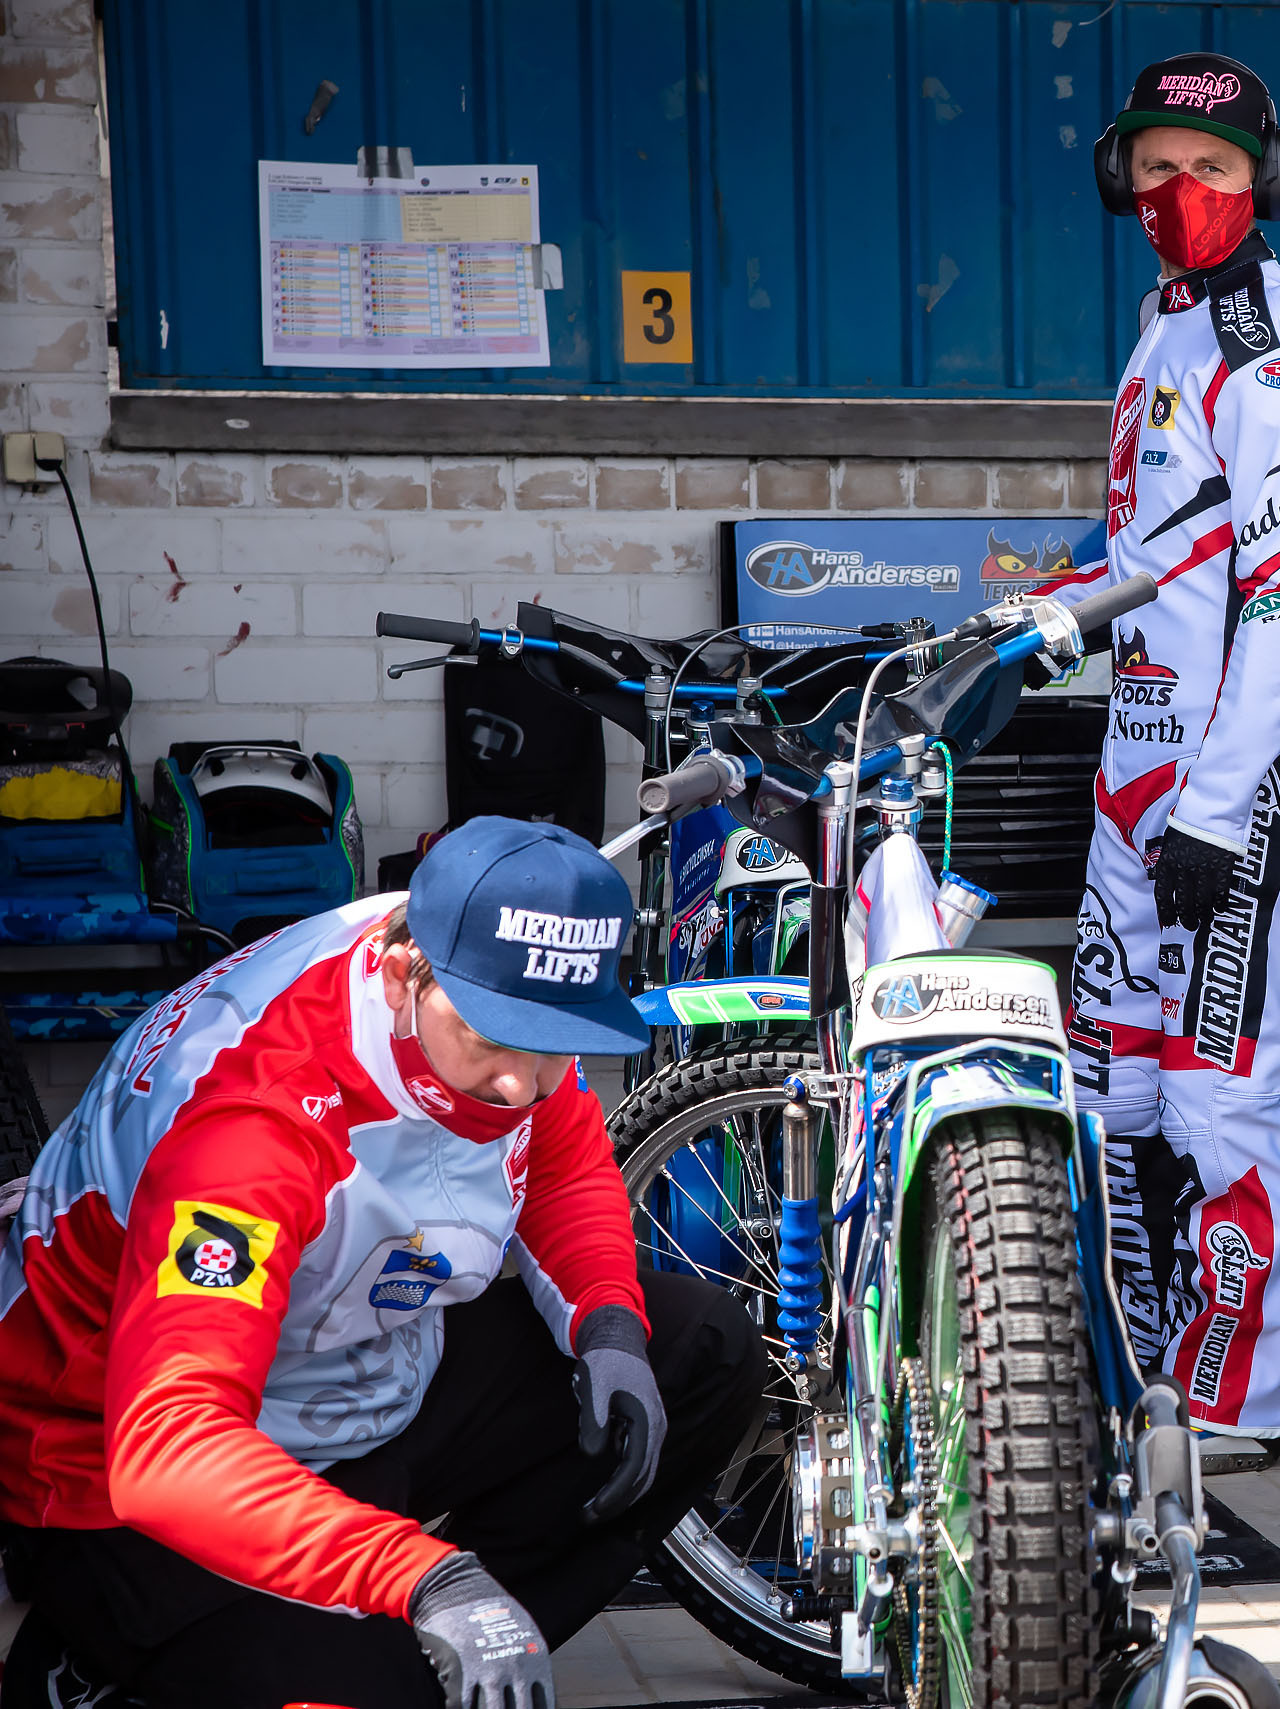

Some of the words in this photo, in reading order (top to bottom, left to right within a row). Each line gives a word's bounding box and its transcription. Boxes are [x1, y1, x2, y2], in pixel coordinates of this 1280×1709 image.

[1157, 75, 1225, 97] MERIDIAN
[1165, 90, 1206, 107] LIFTS
[642, 287, 675, 345] 3
[812, 551, 861, 566] Hans
[830, 564, 959, 585] Andersen
[1110, 709, 1185, 744] North
[496, 906, 623, 951] MERIDIAN
[523, 947, 600, 985] LIFTS
[920, 973, 969, 991] Hans
[1195, 891, 1256, 1068] MERIDIAN
[936, 987, 1050, 1012] Andersen
[1069, 942, 1115, 1097] LIFTS
[1219, 1245, 1246, 1307] LIFTS
[1192, 1315, 1237, 1402] MERIDIAN
